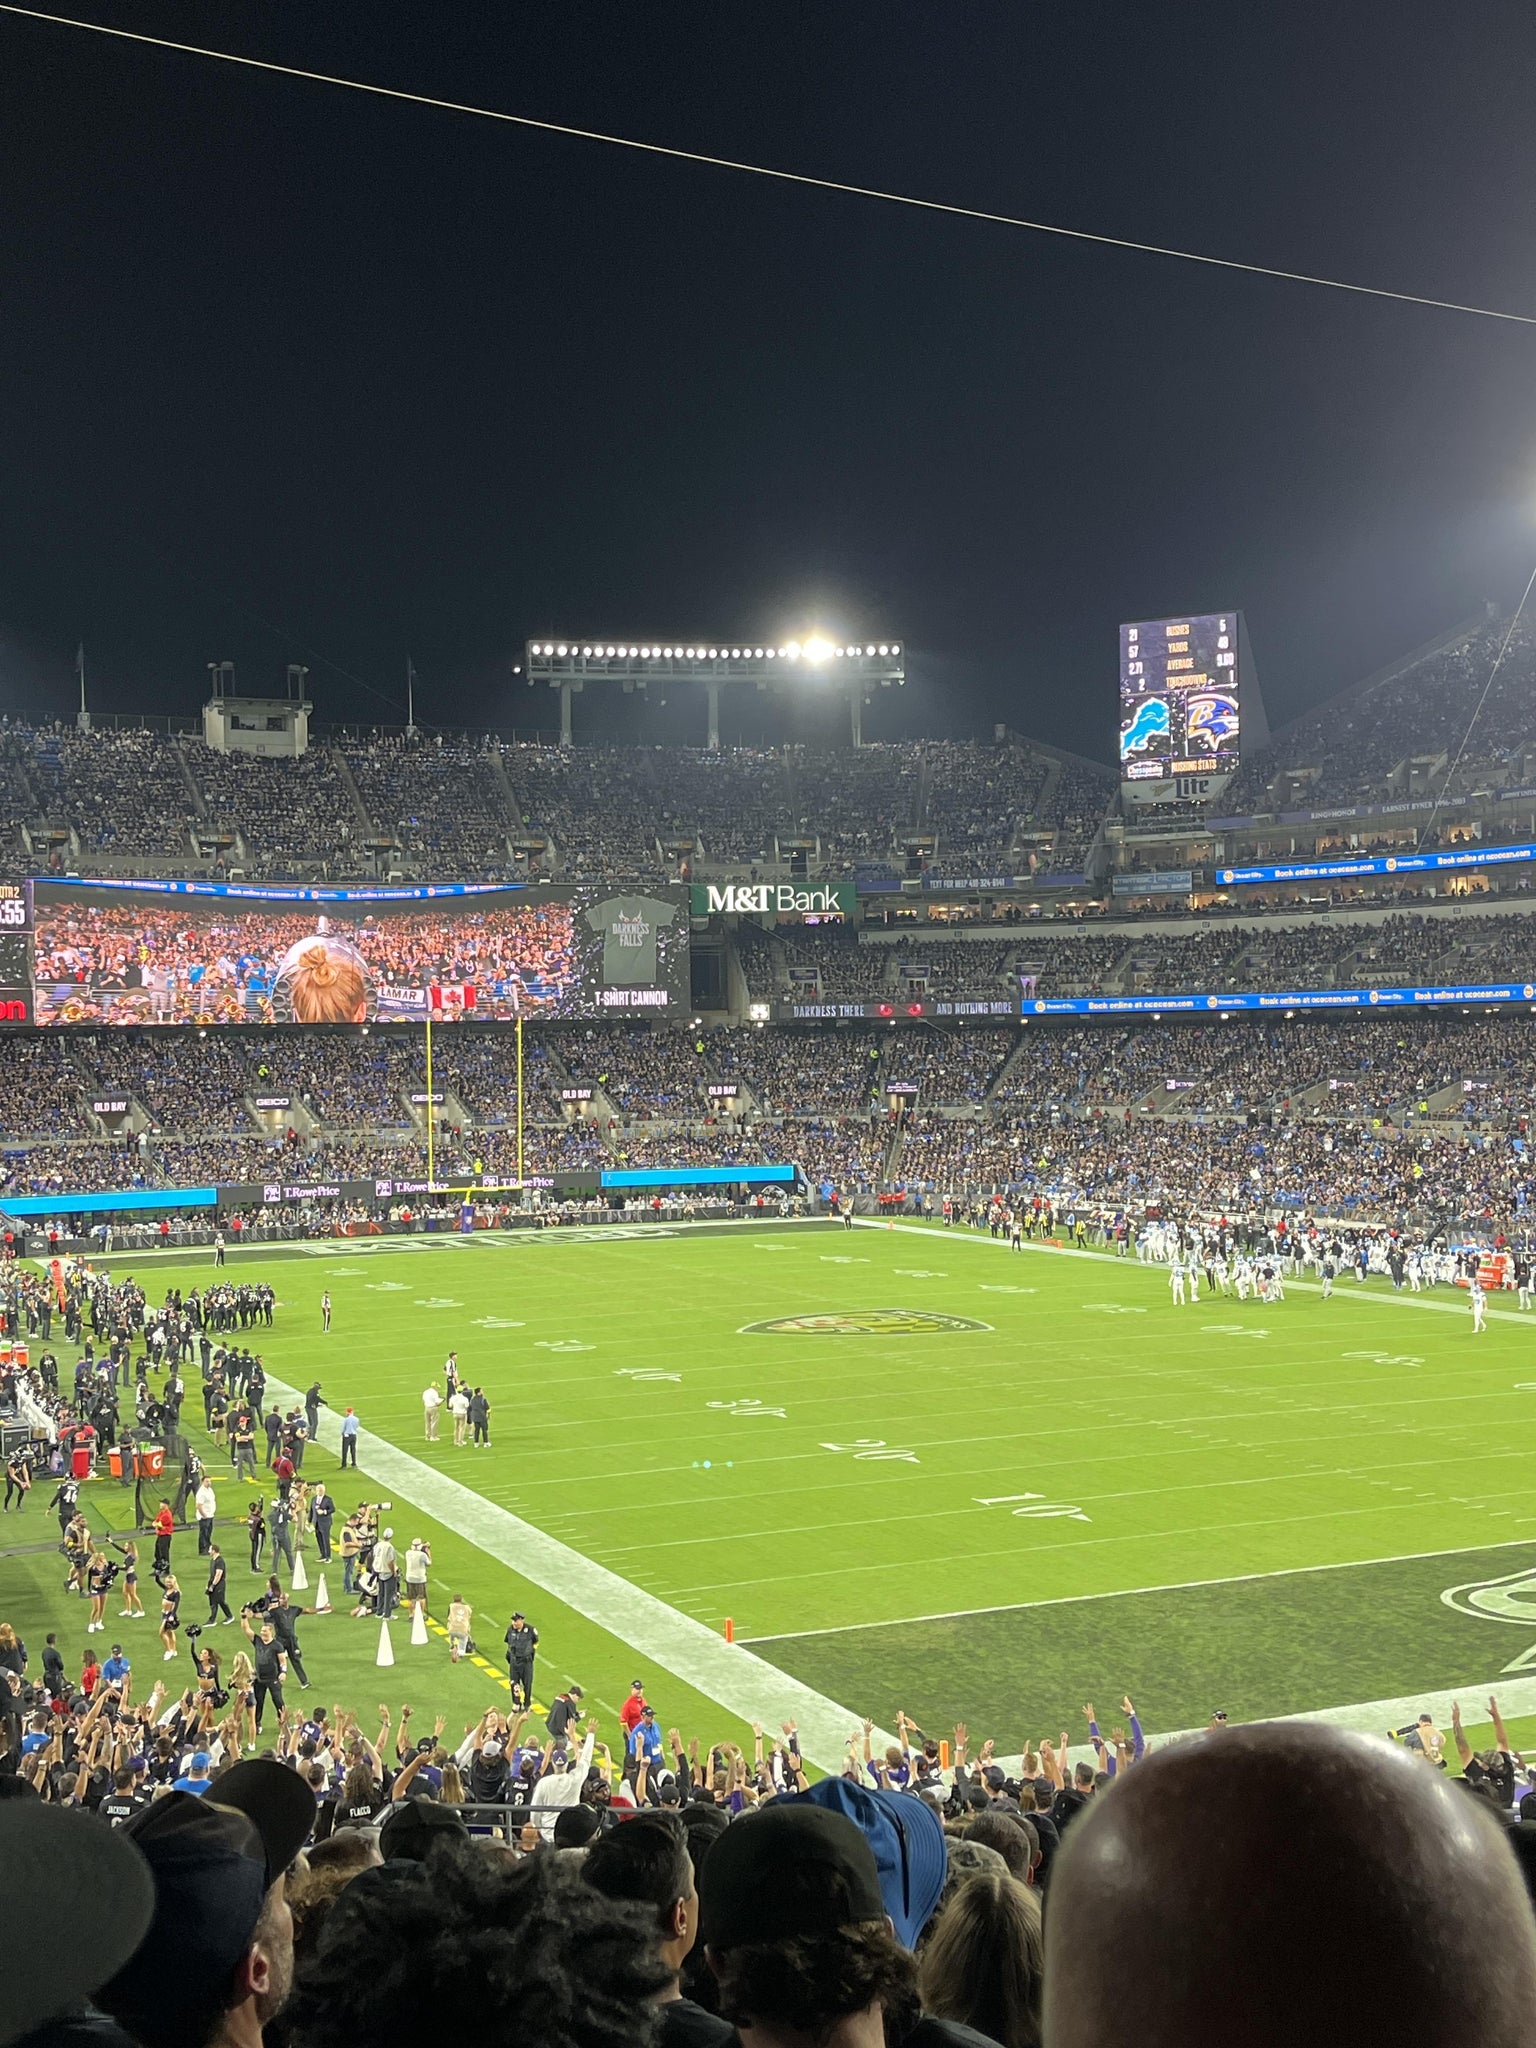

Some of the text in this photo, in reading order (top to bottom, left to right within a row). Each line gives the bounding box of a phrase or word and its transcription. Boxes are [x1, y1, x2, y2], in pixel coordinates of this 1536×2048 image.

[1129, 629, 1138, 642] 21
[1219, 619, 1226, 632] 5
[1128, 645, 1139, 659] 57
[1168, 641, 1188, 654] YARDS
[1167, 658, 1194, 671] AVERAGE
[1138, 669, 1234, 691] 2 TOUCHDOWNS 1
[1171, 758, 1217, 773] RUSHING STATS
[1175, 778, 1209, 799] Lite
[1331, 808, 1356, 818] HONOR
[1382, 803, 1409, 814] EARNEST
[1411, 801, 1433, 810] BYNER
[1437, 857, 1456, 865] Book
[1456, 854, 1477, 863] online
[1275, 869, 1293, 878] Book
[1295, 868, 1318, 876] online
[930, 880, 942, 889] TEXT
[943, 879, 954, 888] FOR
[954, 879, 967, 888] HELP
[14, 886, 20, 898] 2
[706, 884, 841, 912] M&T Bank
[0, 900, 26, 925] :55
[612, 922, 650, 934] DARKNESS
[619, 934, 643, 947] FALLS
[380, 987, 418, 1001] LAMAR
[594, 990, 668, 1006] T-SHIRT CANNON
[1260, 997, 1278, 1005] Book
[1280, 996, 1301, 1004] online
[1415, 992, 1432, 1000] Book
[1433, 991, 1455, 999] online
[793, 1004, 864, 1017] DARKNESS THERE
[936, 1001, 1013, 1015] AND NOTHING MORE
[1109, 1001, 1133, 1009] online
[562, 1089, 591, 1098] OLD BAY
[708, 1085, 737, 1095] OLD BAY
[94, 1101, 126, 1112] OLD BAY
[256, 1098, 289, 1106] GEICO
[533, 1177, 554, 1187] Price
[316, 1185, 340, 1196] Price
[705, 1399, 787, 1417] 30
[818, 1439, 918, 1462] 20
[64, 1488, 77, 1503] 46
[971, 1492, 1088, 1521] 10
[107, 1805, 130, 1816] JACKSON
[349, 1805, 372, 1818] FLACCO
